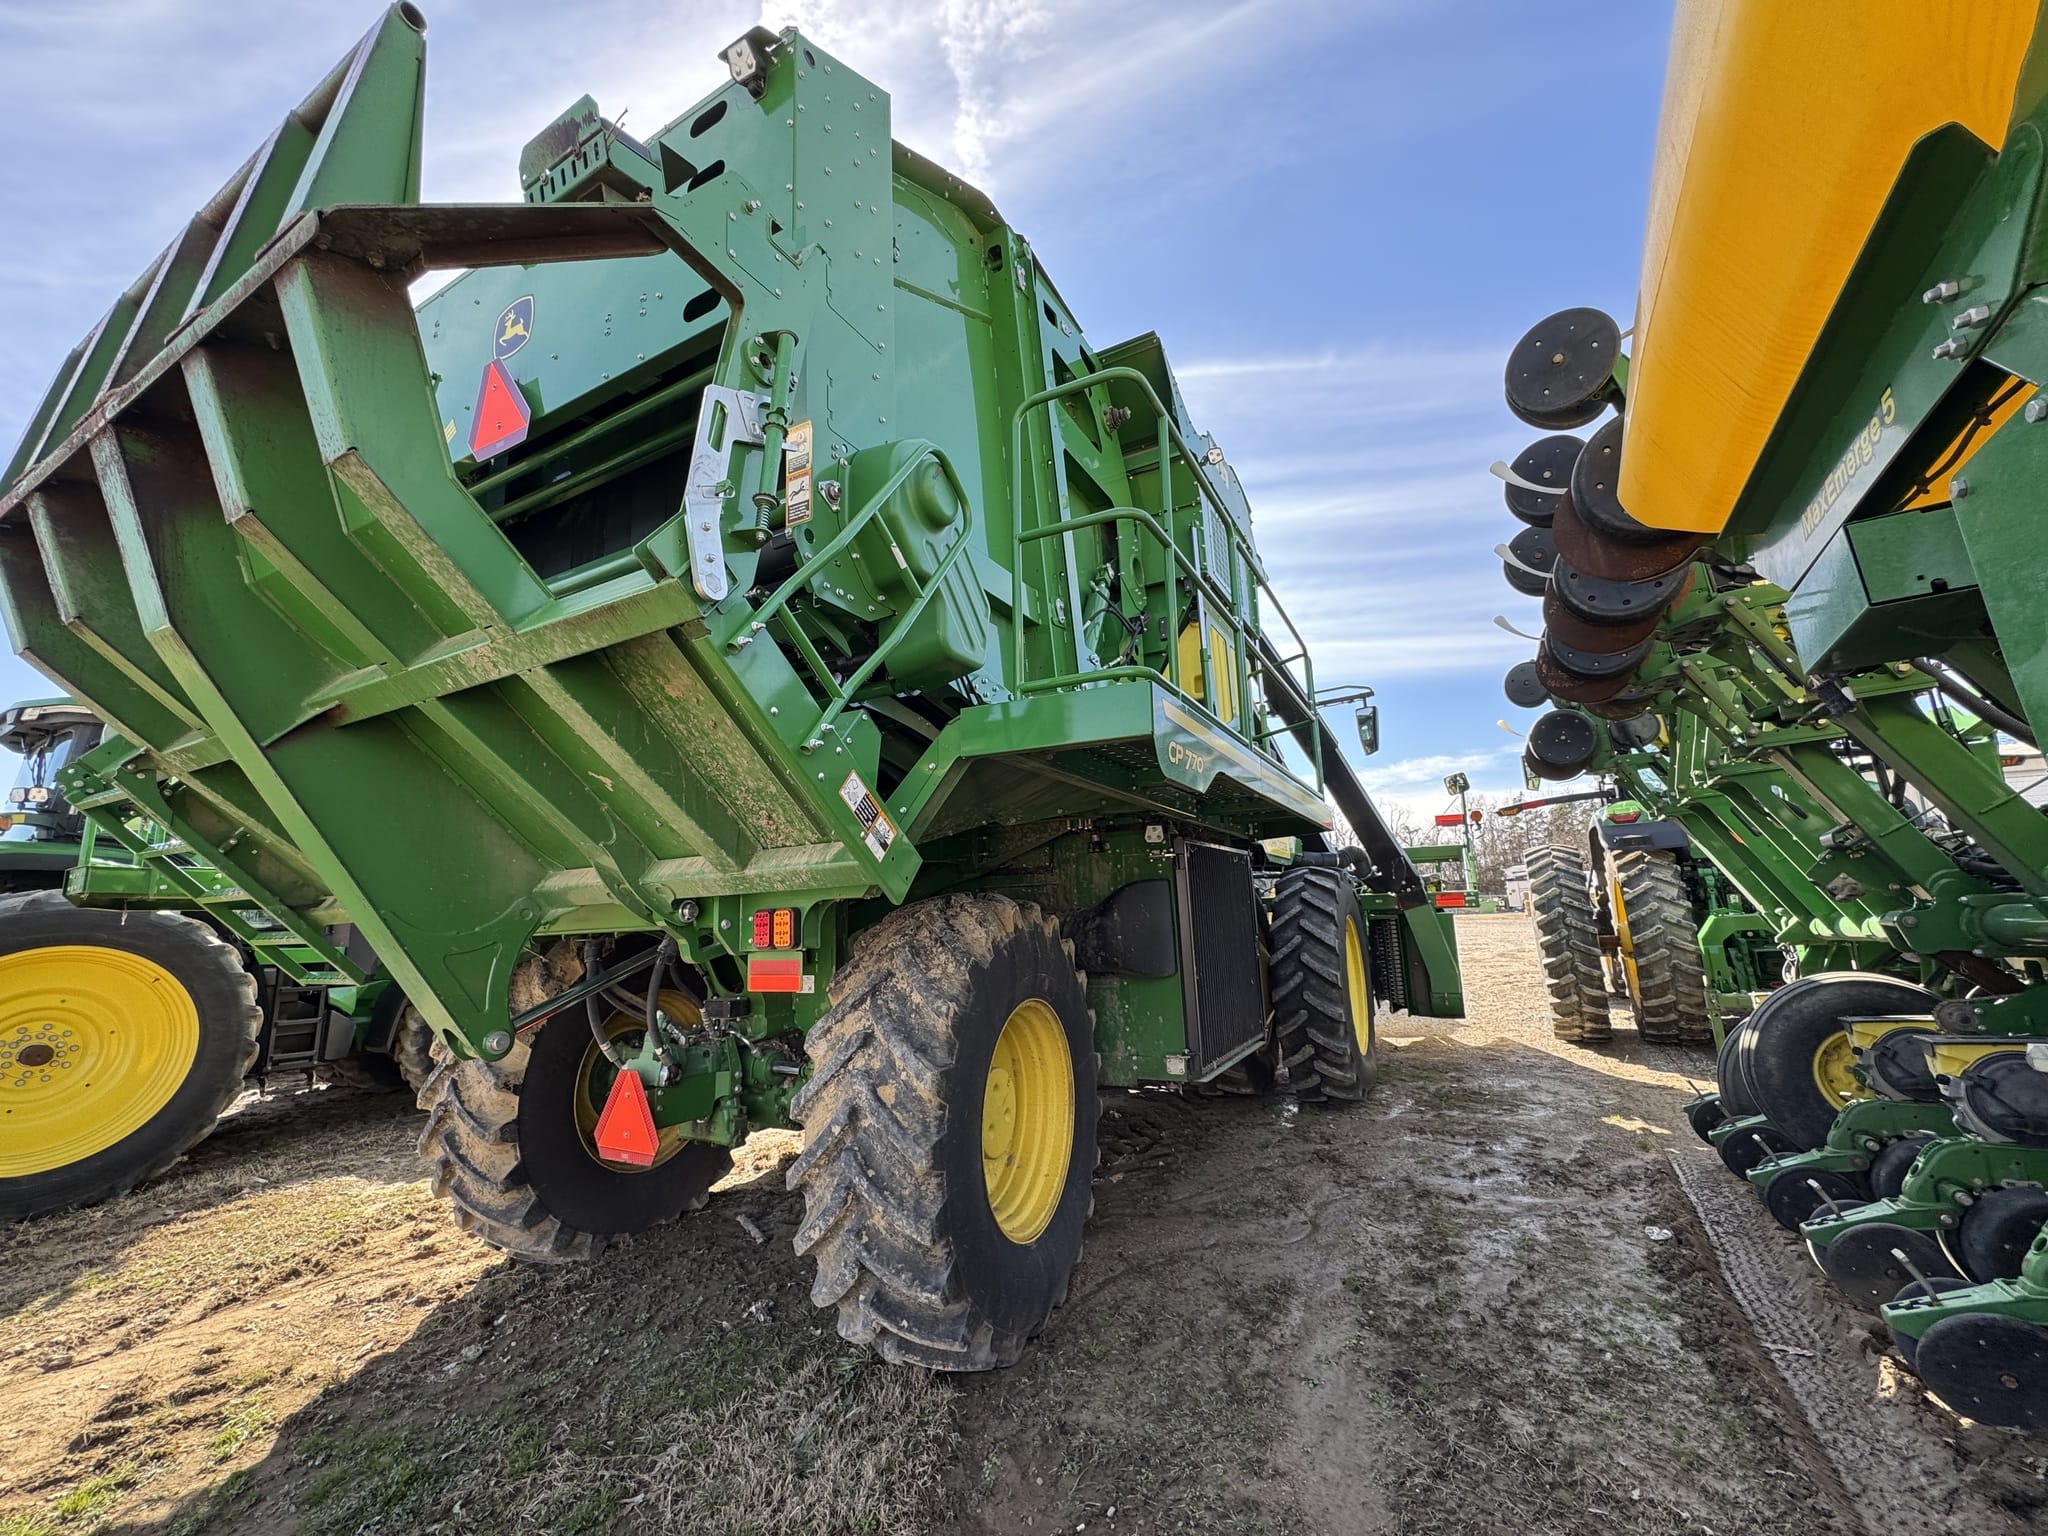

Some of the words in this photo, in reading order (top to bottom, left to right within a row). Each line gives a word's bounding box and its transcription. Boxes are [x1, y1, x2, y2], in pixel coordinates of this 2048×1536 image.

[1801, 416, 1882, 540] MaxEmerge
[1880, 385, 1896, 425] 5
[1168, 740, 1184, 765] CP
[1185, 749, 1204, 774] 770
